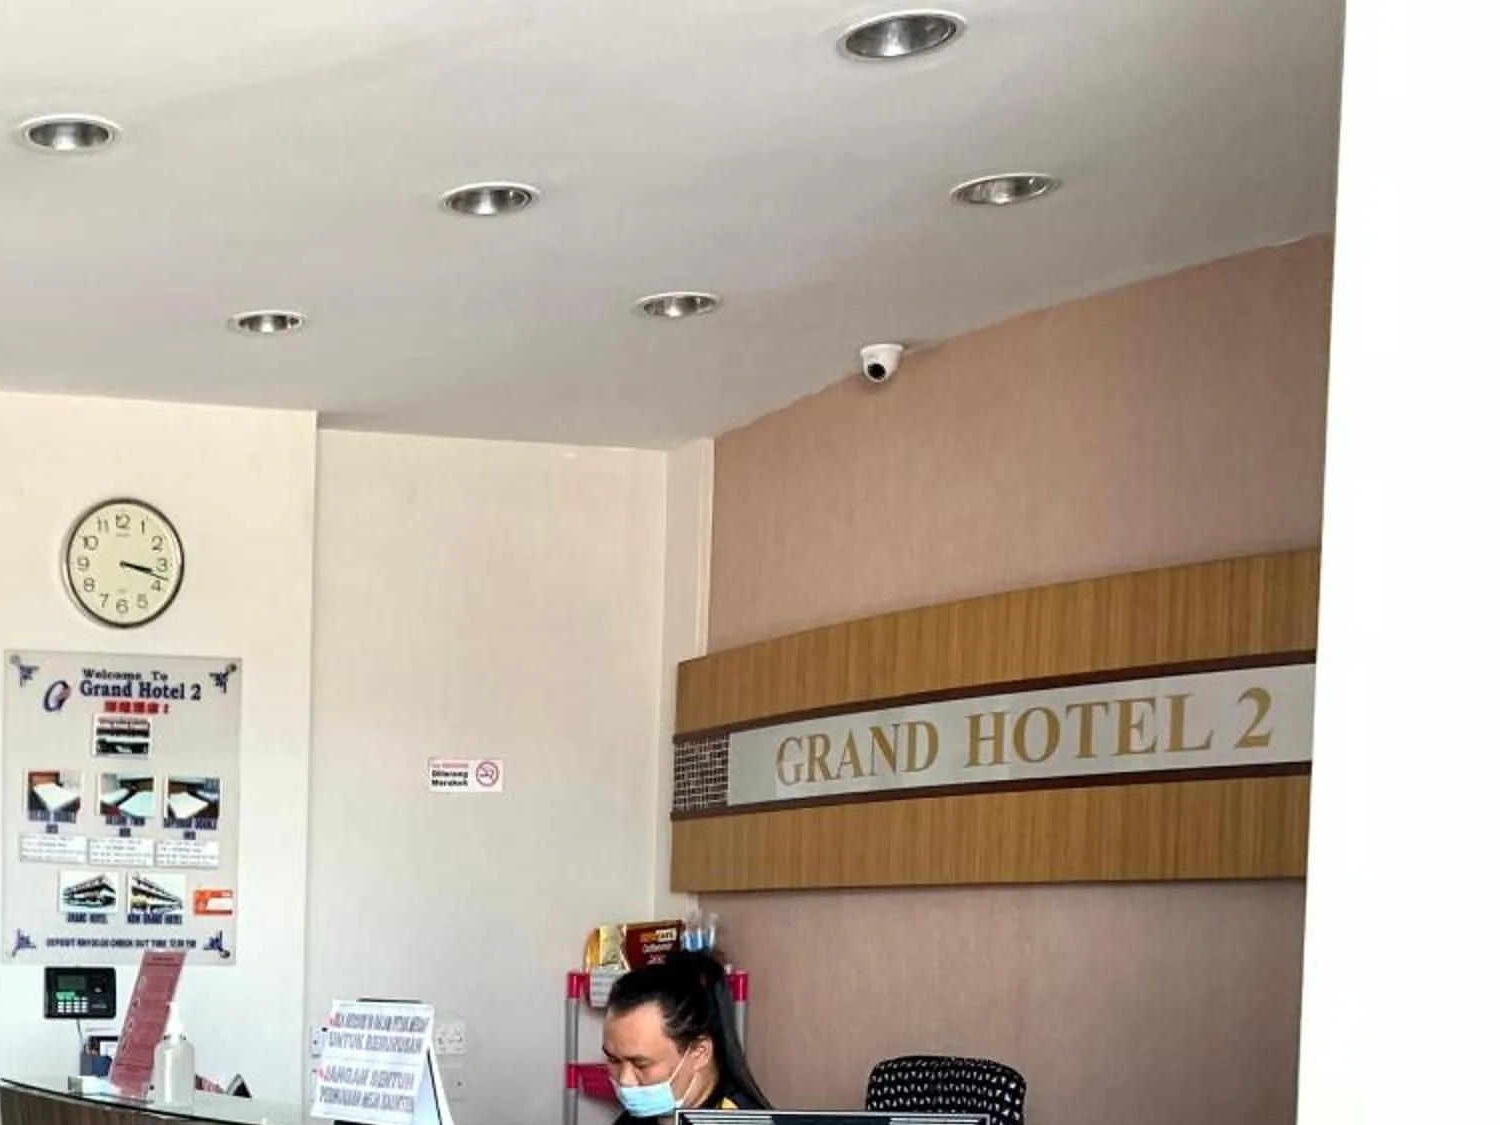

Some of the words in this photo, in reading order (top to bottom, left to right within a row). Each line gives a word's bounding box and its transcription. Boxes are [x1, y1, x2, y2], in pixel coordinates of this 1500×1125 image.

[116, 513, 131, 529] 12
[83, 535, 98, 550] 10
[152, 535, 162, 551] 2
[77, 557, 89, 571] 9
[157, 557, 168, 572] 3
[83, 578, 95, 592] 8
[151, 579, 163, 591] 4
[100, 593, 109, 608] 7
[116, 599, 128, 613] 6
[137, 594, 148, 608] 5
[83, 667, 142, 680] Welcome
[151, 671, 168, 681] To
[80, 679, 132, 697] Grand
[139, 681, 185, 700] Hotel
[191, 683, 201, 700] 2
[775, 720, 939, 786] GRAND
[964, 692, 1214, 769] HOTEL
[1234, 687, 1274, 749] 2
[329, 1031, 365, 1050] UNTUK
[324, 1064, 370, 1086] JANGAN
[370, 1069, 414, 1090] SENTUH
